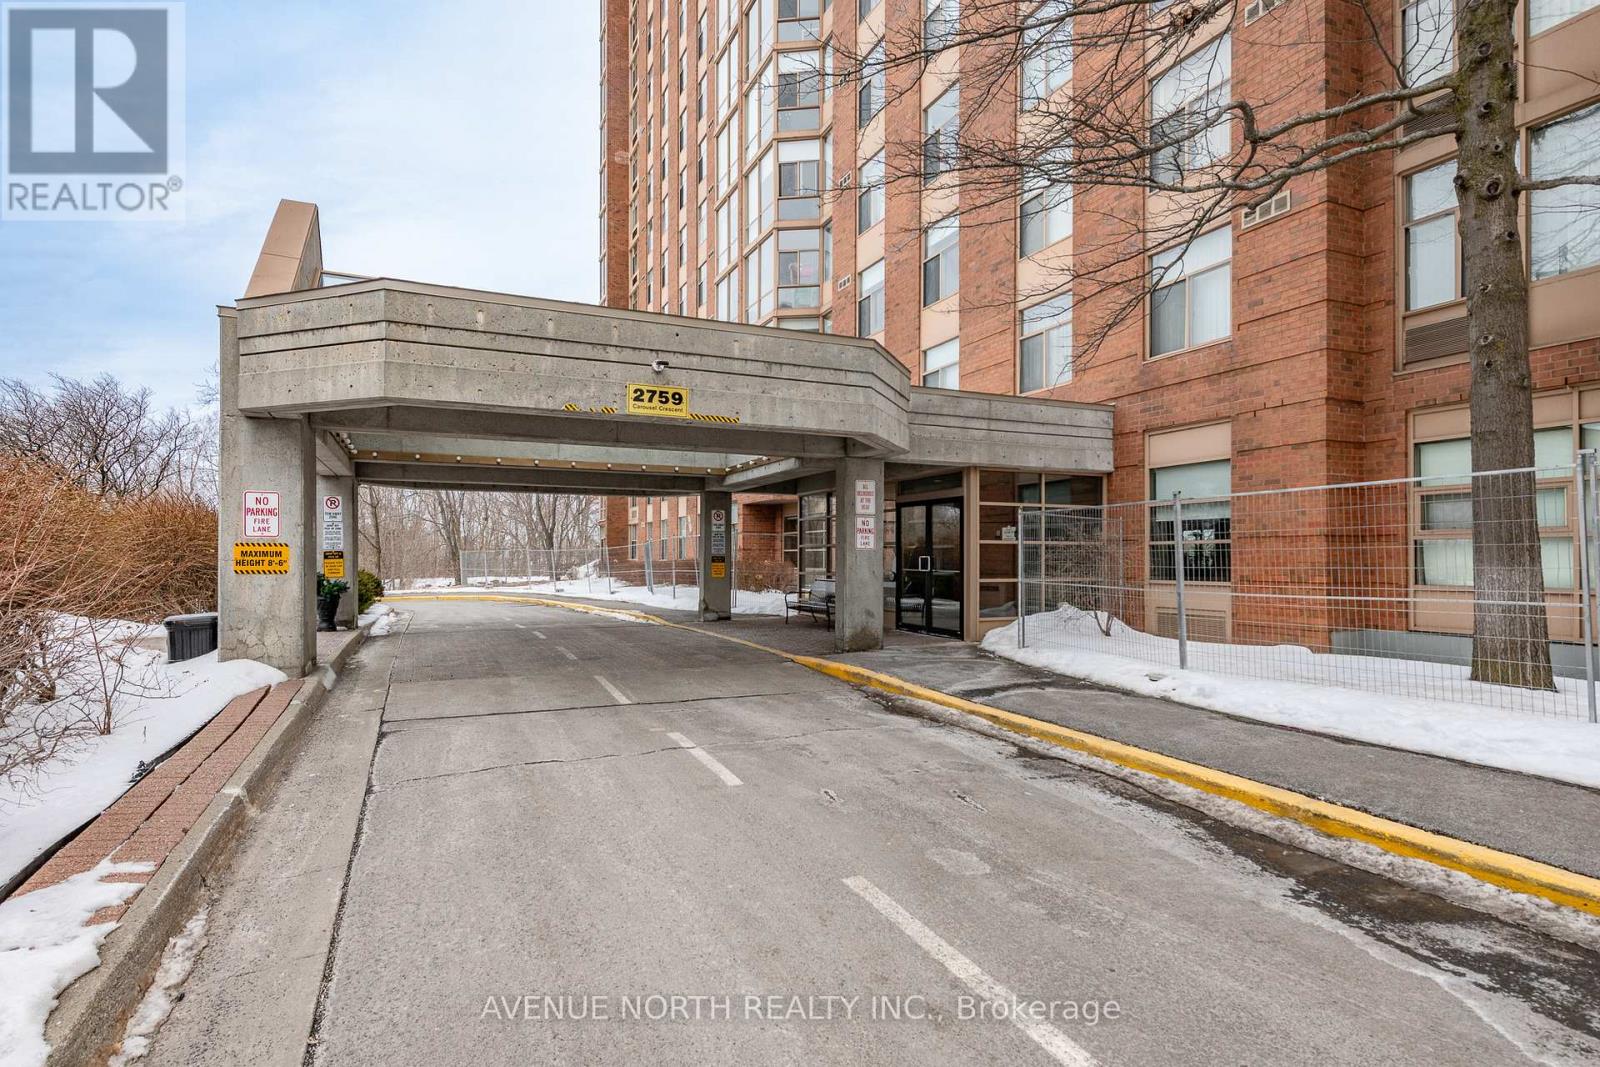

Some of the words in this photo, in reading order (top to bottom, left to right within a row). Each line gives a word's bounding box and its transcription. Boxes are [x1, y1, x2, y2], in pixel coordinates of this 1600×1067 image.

[632, 388, 684, 406] 2759
[632, 403, 658, 411] Carousel
[658, 405, 684, 413] Crescent
[255, 496, 269, 506] NO
[246, 507, 278, 517] PARKING
[861, 519, 870, 527] NO
[240, 550, 283, 558] MAXIMUM
[235, 559, 266, 567] HEIGHT
